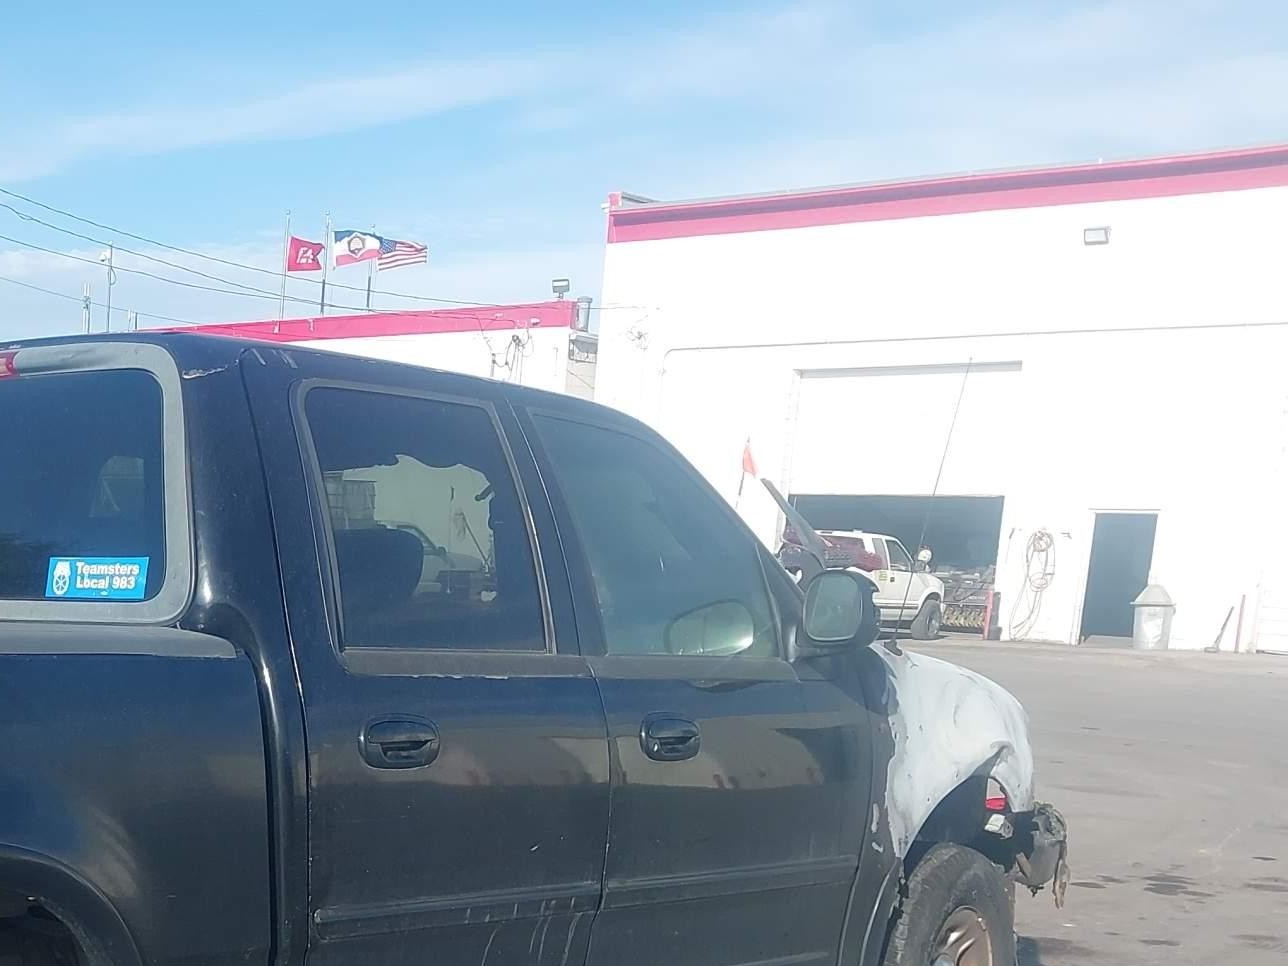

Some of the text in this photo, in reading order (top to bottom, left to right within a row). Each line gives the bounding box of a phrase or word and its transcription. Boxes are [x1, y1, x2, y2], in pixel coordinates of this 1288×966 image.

[75, 561, 140, 575] Teamsters
[75, 576, 136, 589] Local 983
